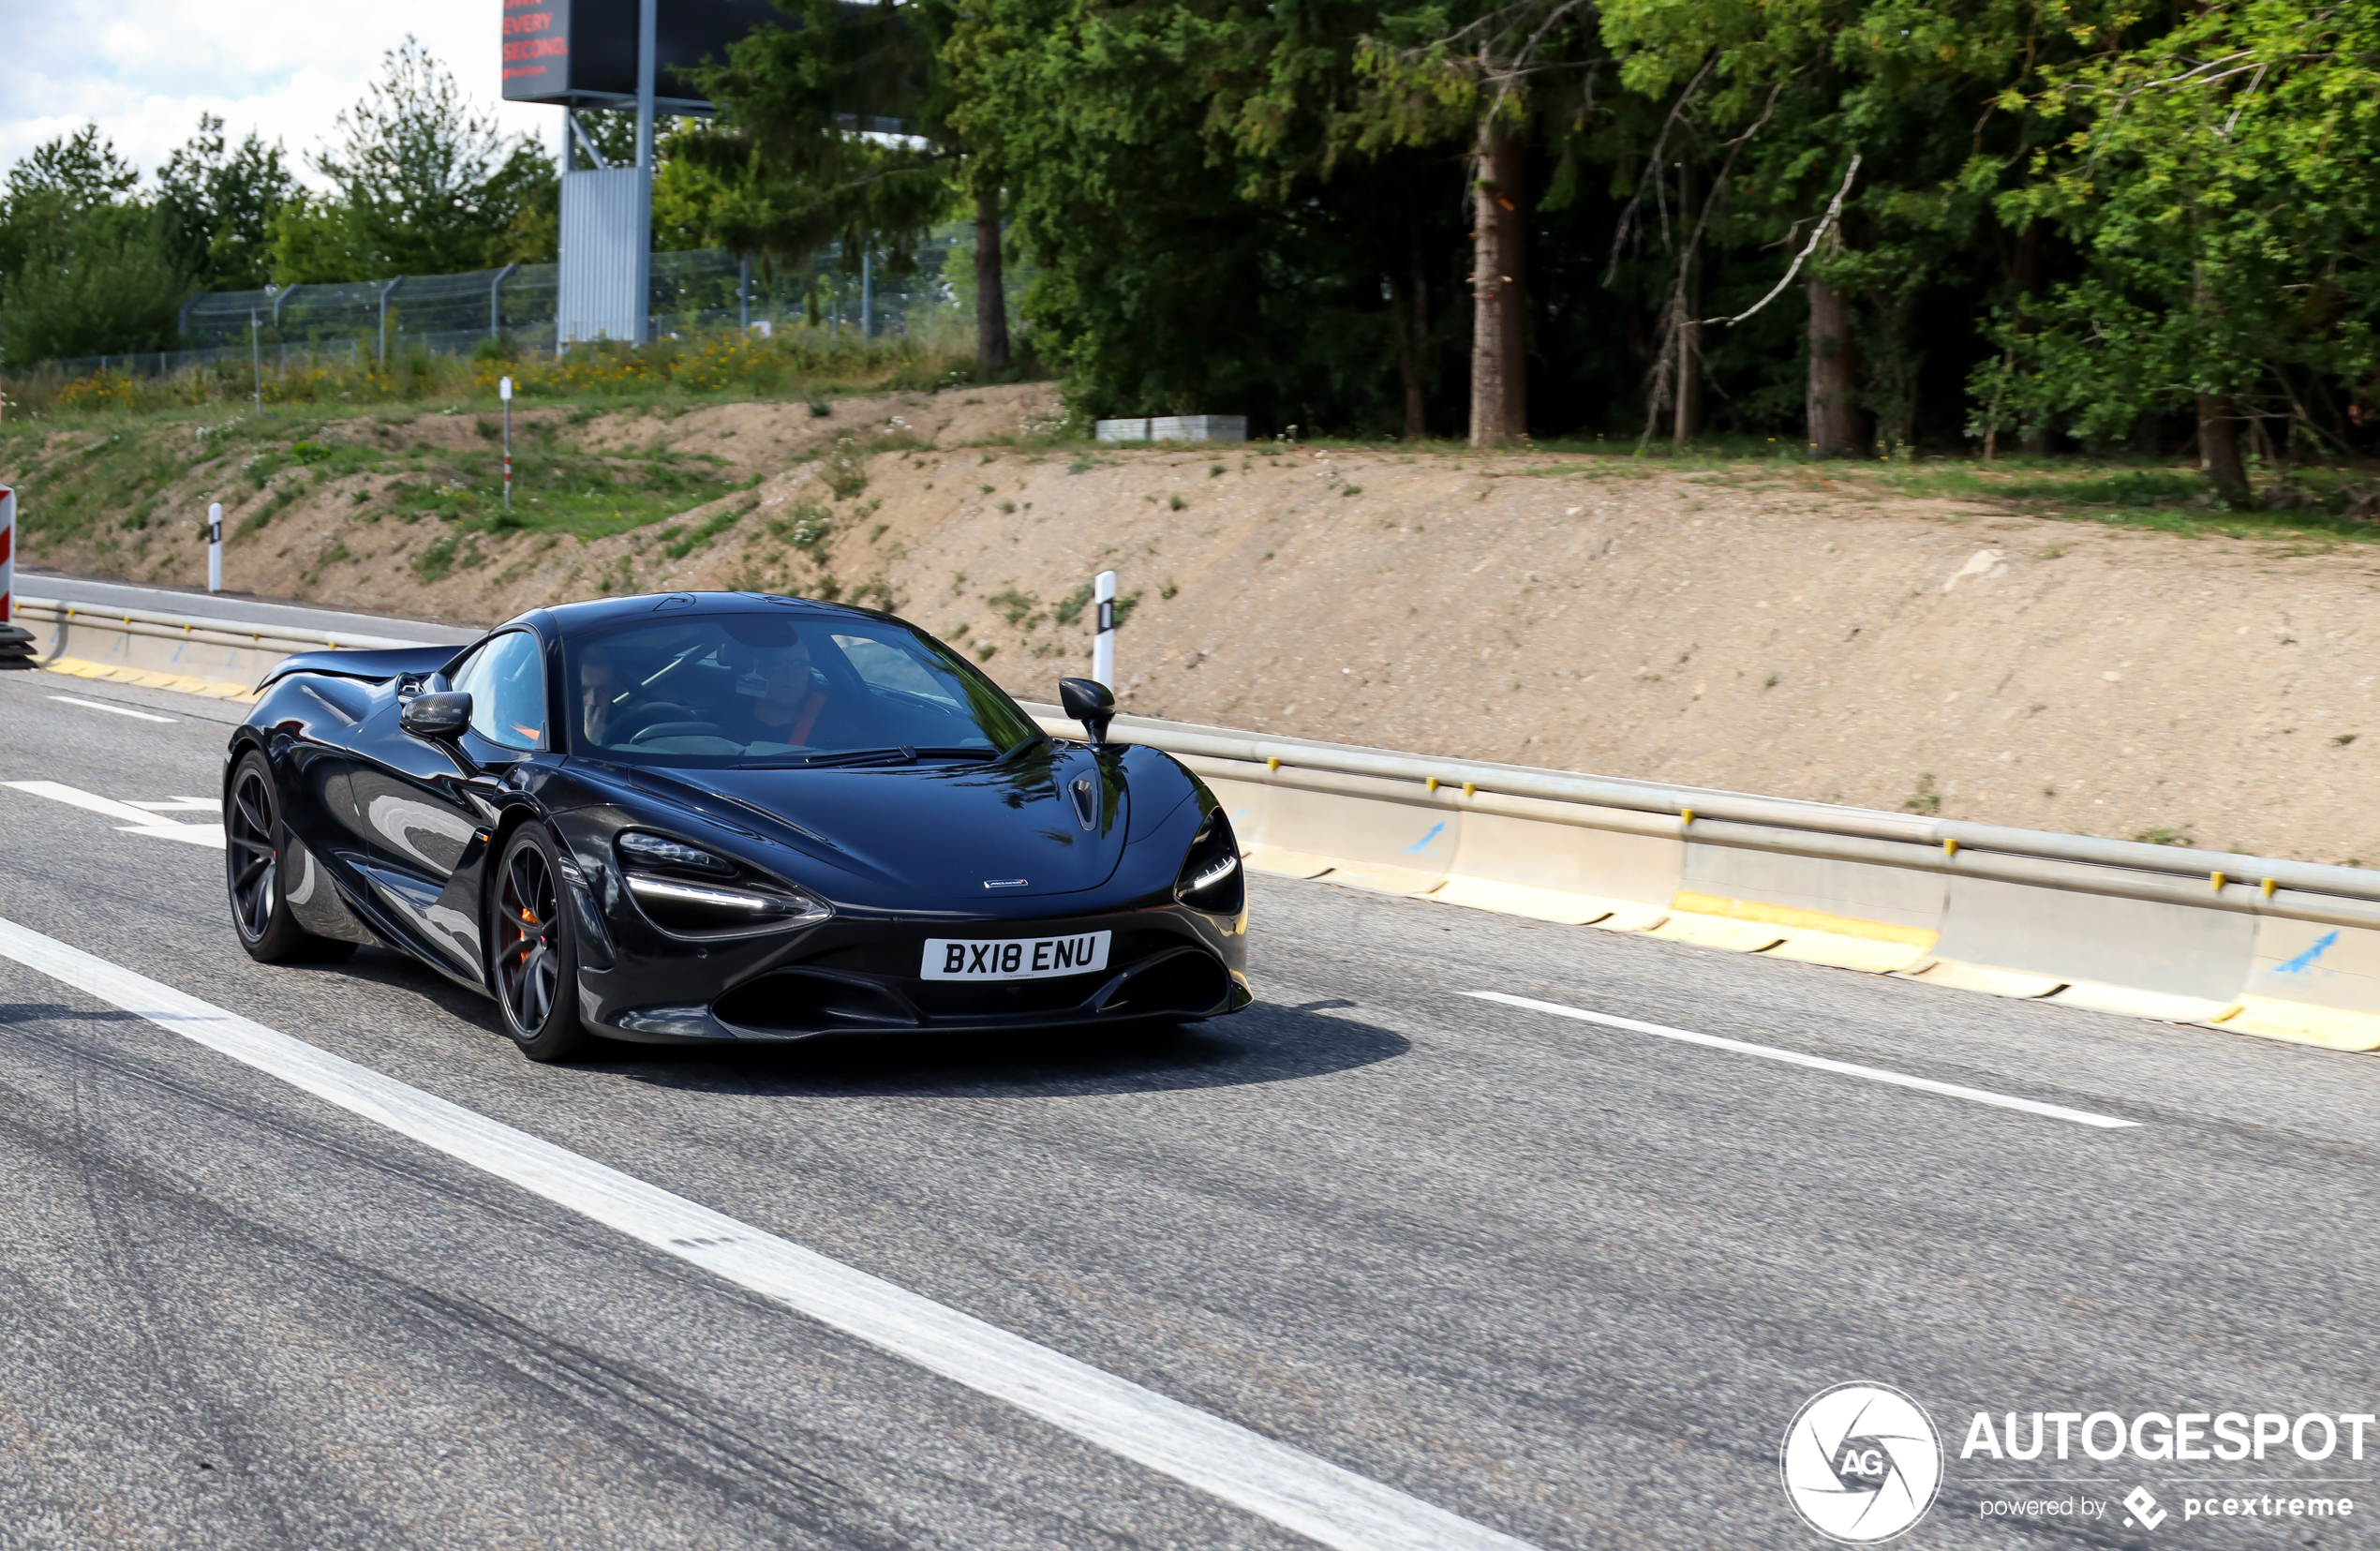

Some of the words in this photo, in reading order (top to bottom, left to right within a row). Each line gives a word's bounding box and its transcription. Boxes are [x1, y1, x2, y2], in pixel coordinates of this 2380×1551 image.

[503, 11, 552, 35] EVERY
[943, 943, 1022, 974] BX18
[1032, 935, 1095, 971] ENU
